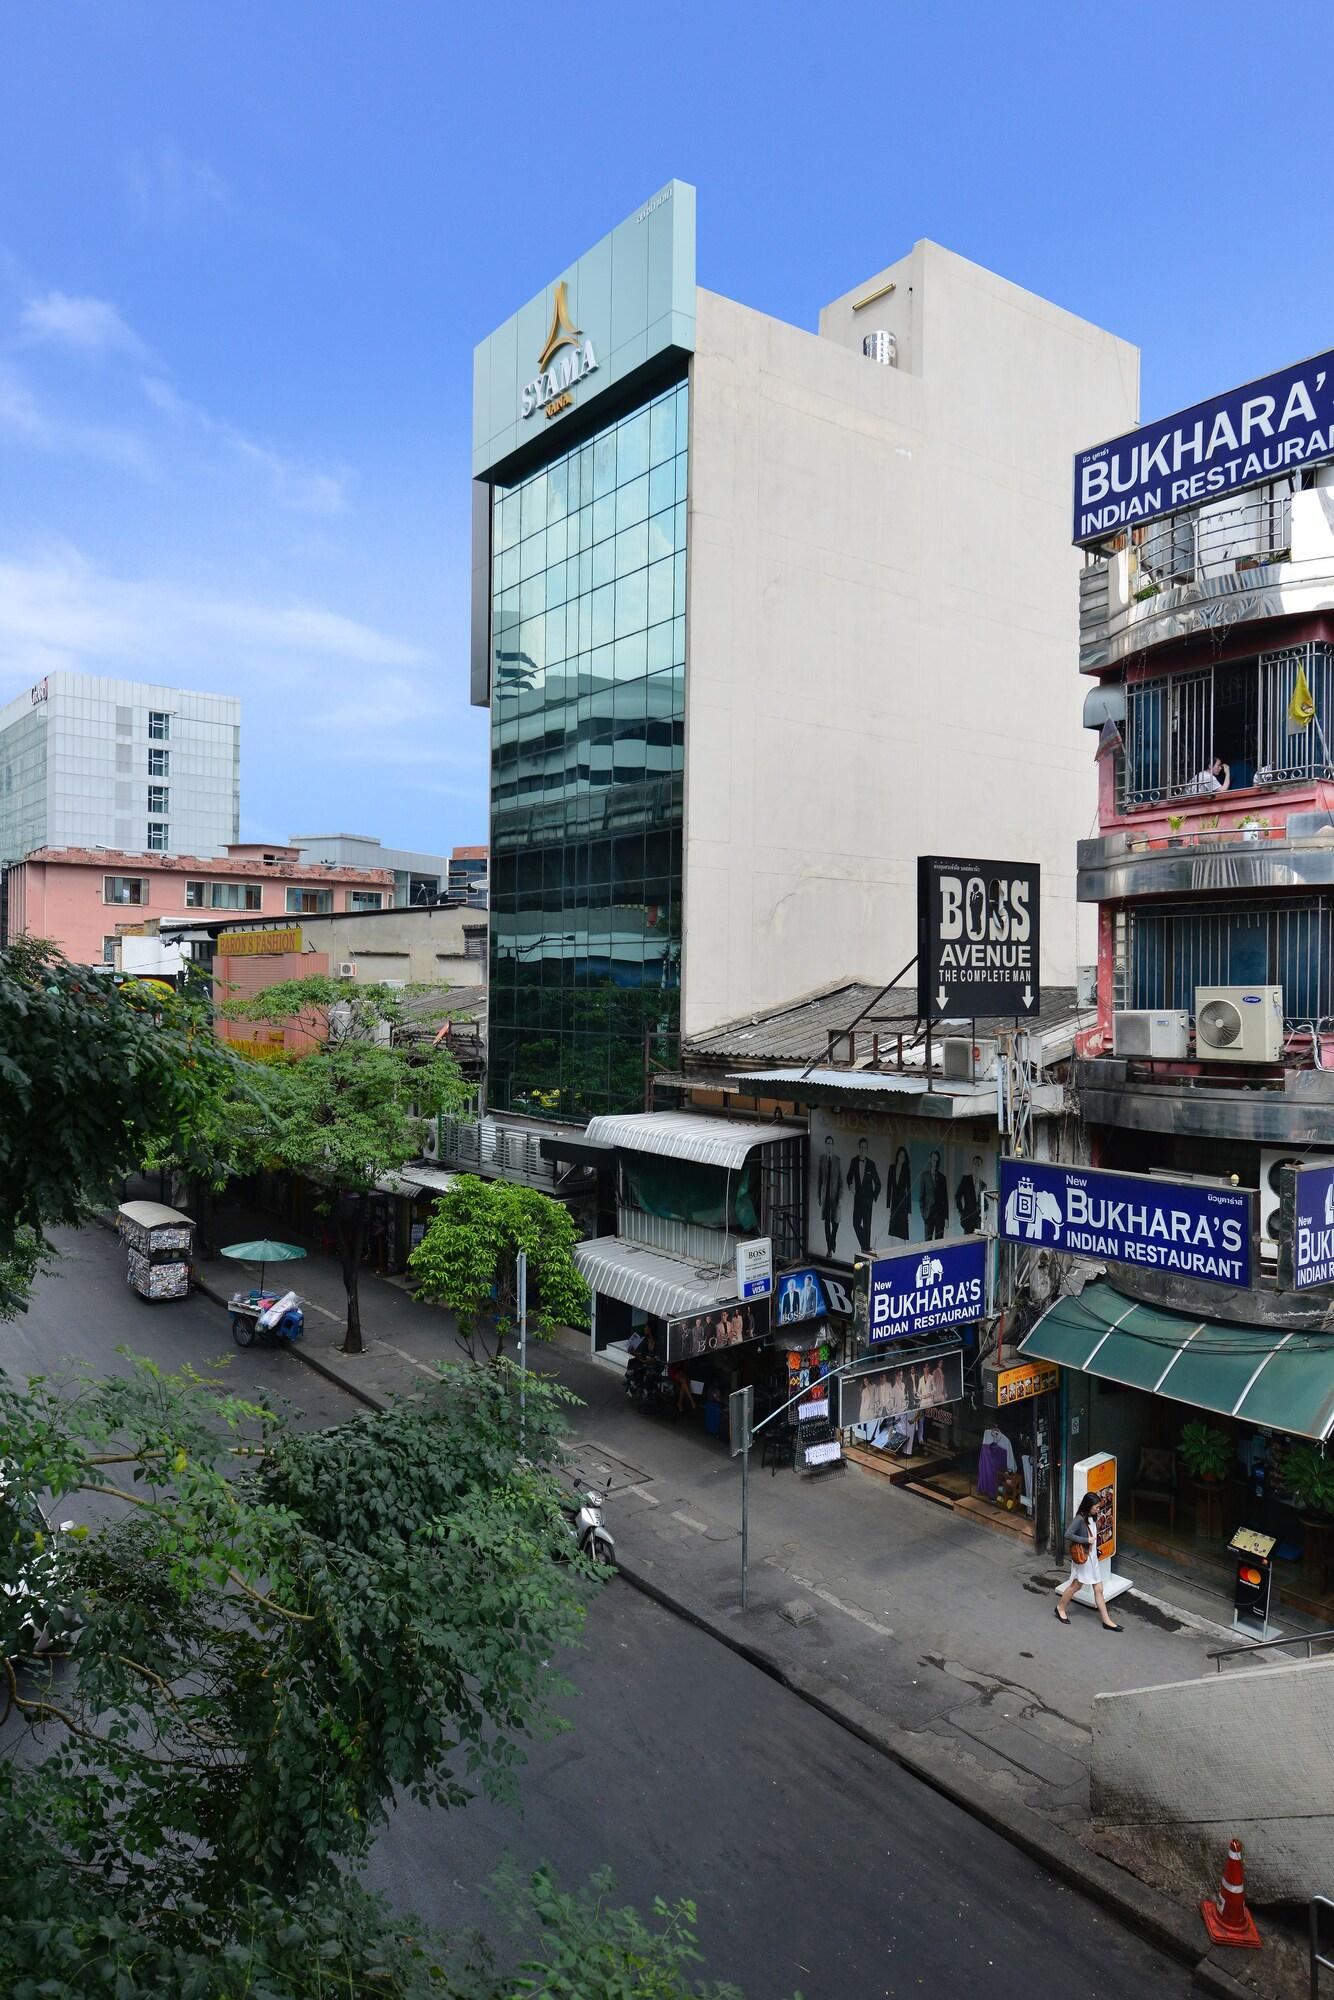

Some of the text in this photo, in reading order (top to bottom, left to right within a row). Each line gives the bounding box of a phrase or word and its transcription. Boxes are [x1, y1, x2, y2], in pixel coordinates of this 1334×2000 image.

[521, 340, 599, 418] SYAMA
[1081, 371, 1334, 506] BUKHARA'
[1081, 488, 1161, 535] INDIAN
[939, 876, 1031, 942] BOSS
[220, 932, 296, 954] BARON'S FASHION
[939, 944, 1032, 967] AVENUE
[939, 969, 1031, 982] THE COMPLETE MAN
[1065, 1174, 1087, 1188] New
[1066, 1187, 1242, 1252] BUKHARA'S
[1298, 1216, 1312, 1227] New
[748, 1249, 767, 1260] BOSS
[1066, 1231, 1243, 1280] INDIAN RESTAURANT
[1298, 1228, 1334, 1266] BUK
[874, 1281, 892, 1291] New
[1297, 1262, 1327, 1287] INDIAN
[873, 1278, 981, 1323] BUKHARA'S
[872, 1304, 981, 1340] INDIAN RESTAURANT
